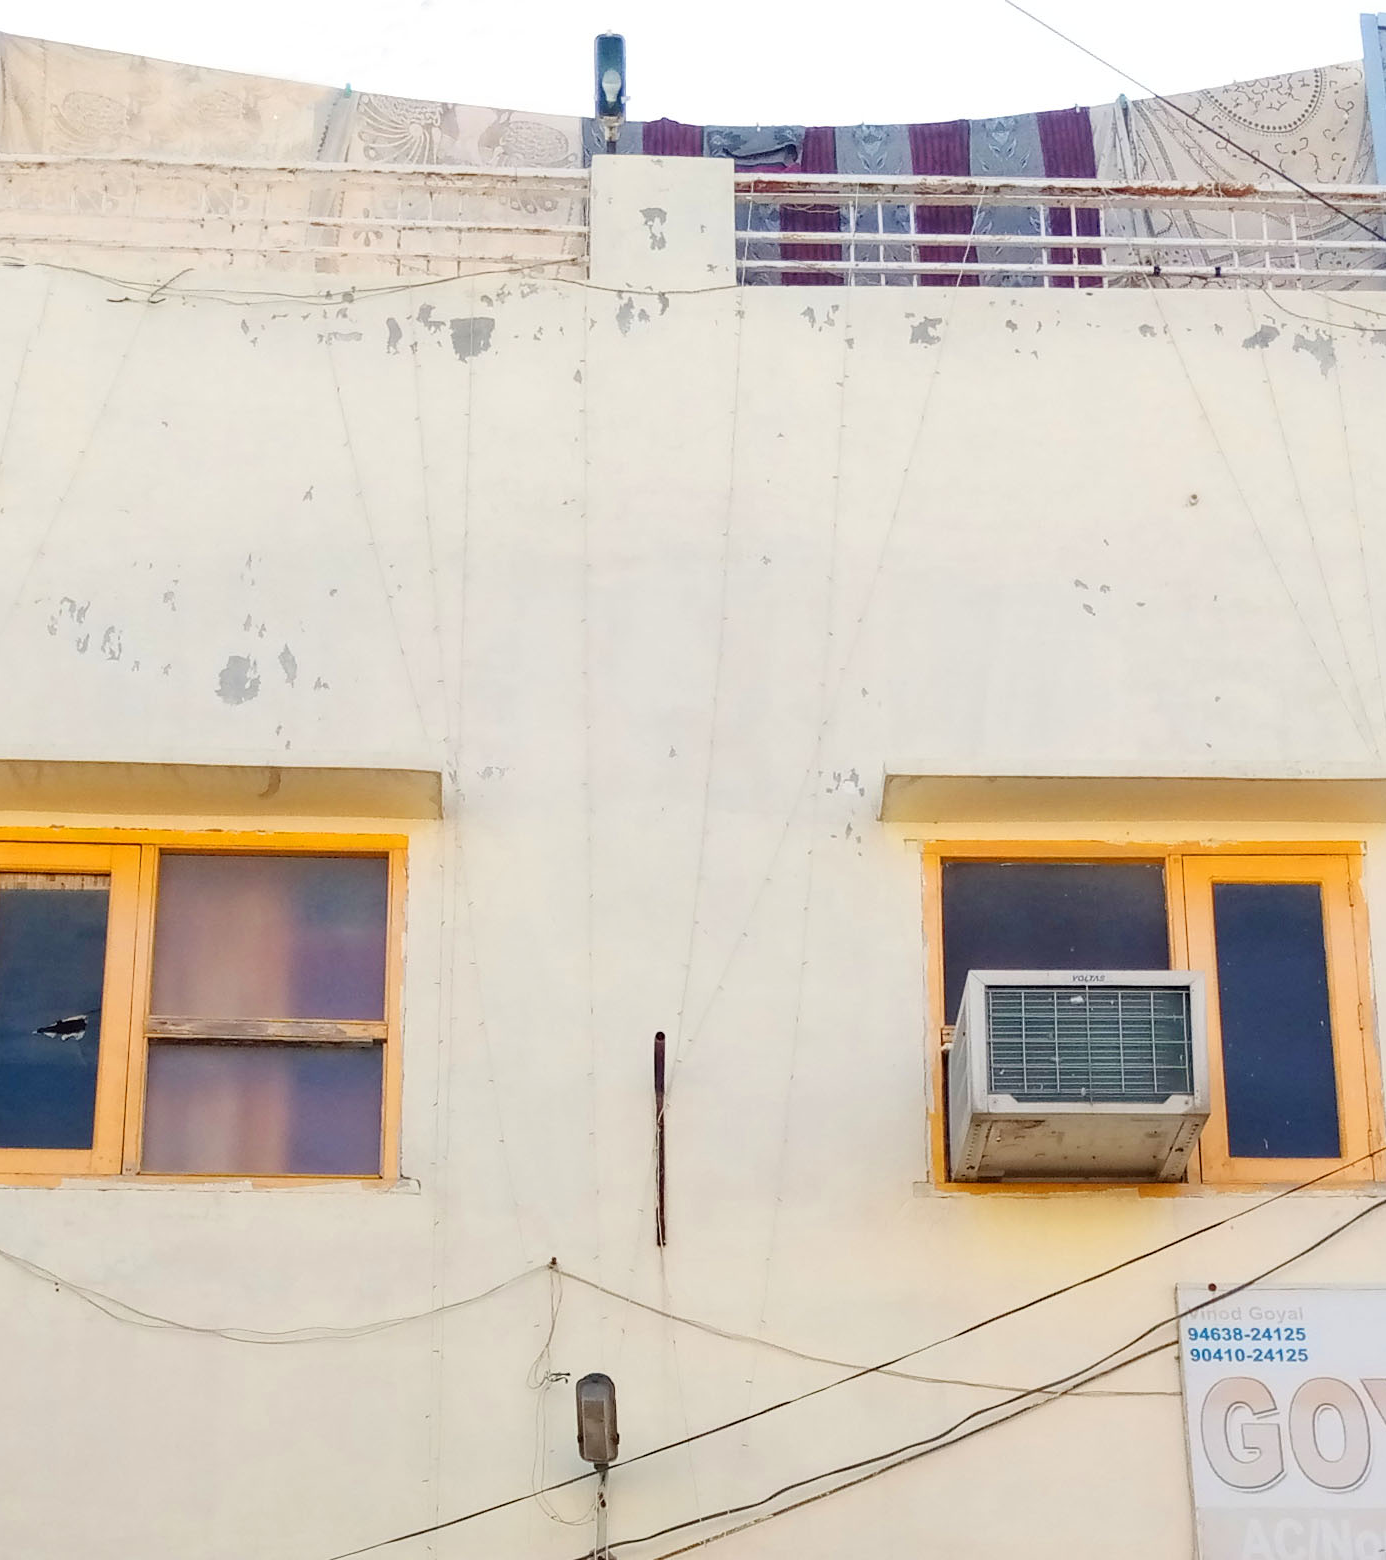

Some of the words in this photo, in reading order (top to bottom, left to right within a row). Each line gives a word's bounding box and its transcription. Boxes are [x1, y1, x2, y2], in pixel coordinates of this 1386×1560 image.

[1071, 974, 1106, 983] VOLTAS
[1249, 1306, 1304, 1324] Goyal
[1188, 1327, 1307, 1342] 94638-24125
[1190, 1348, 1309, 1363] 90410-24125
